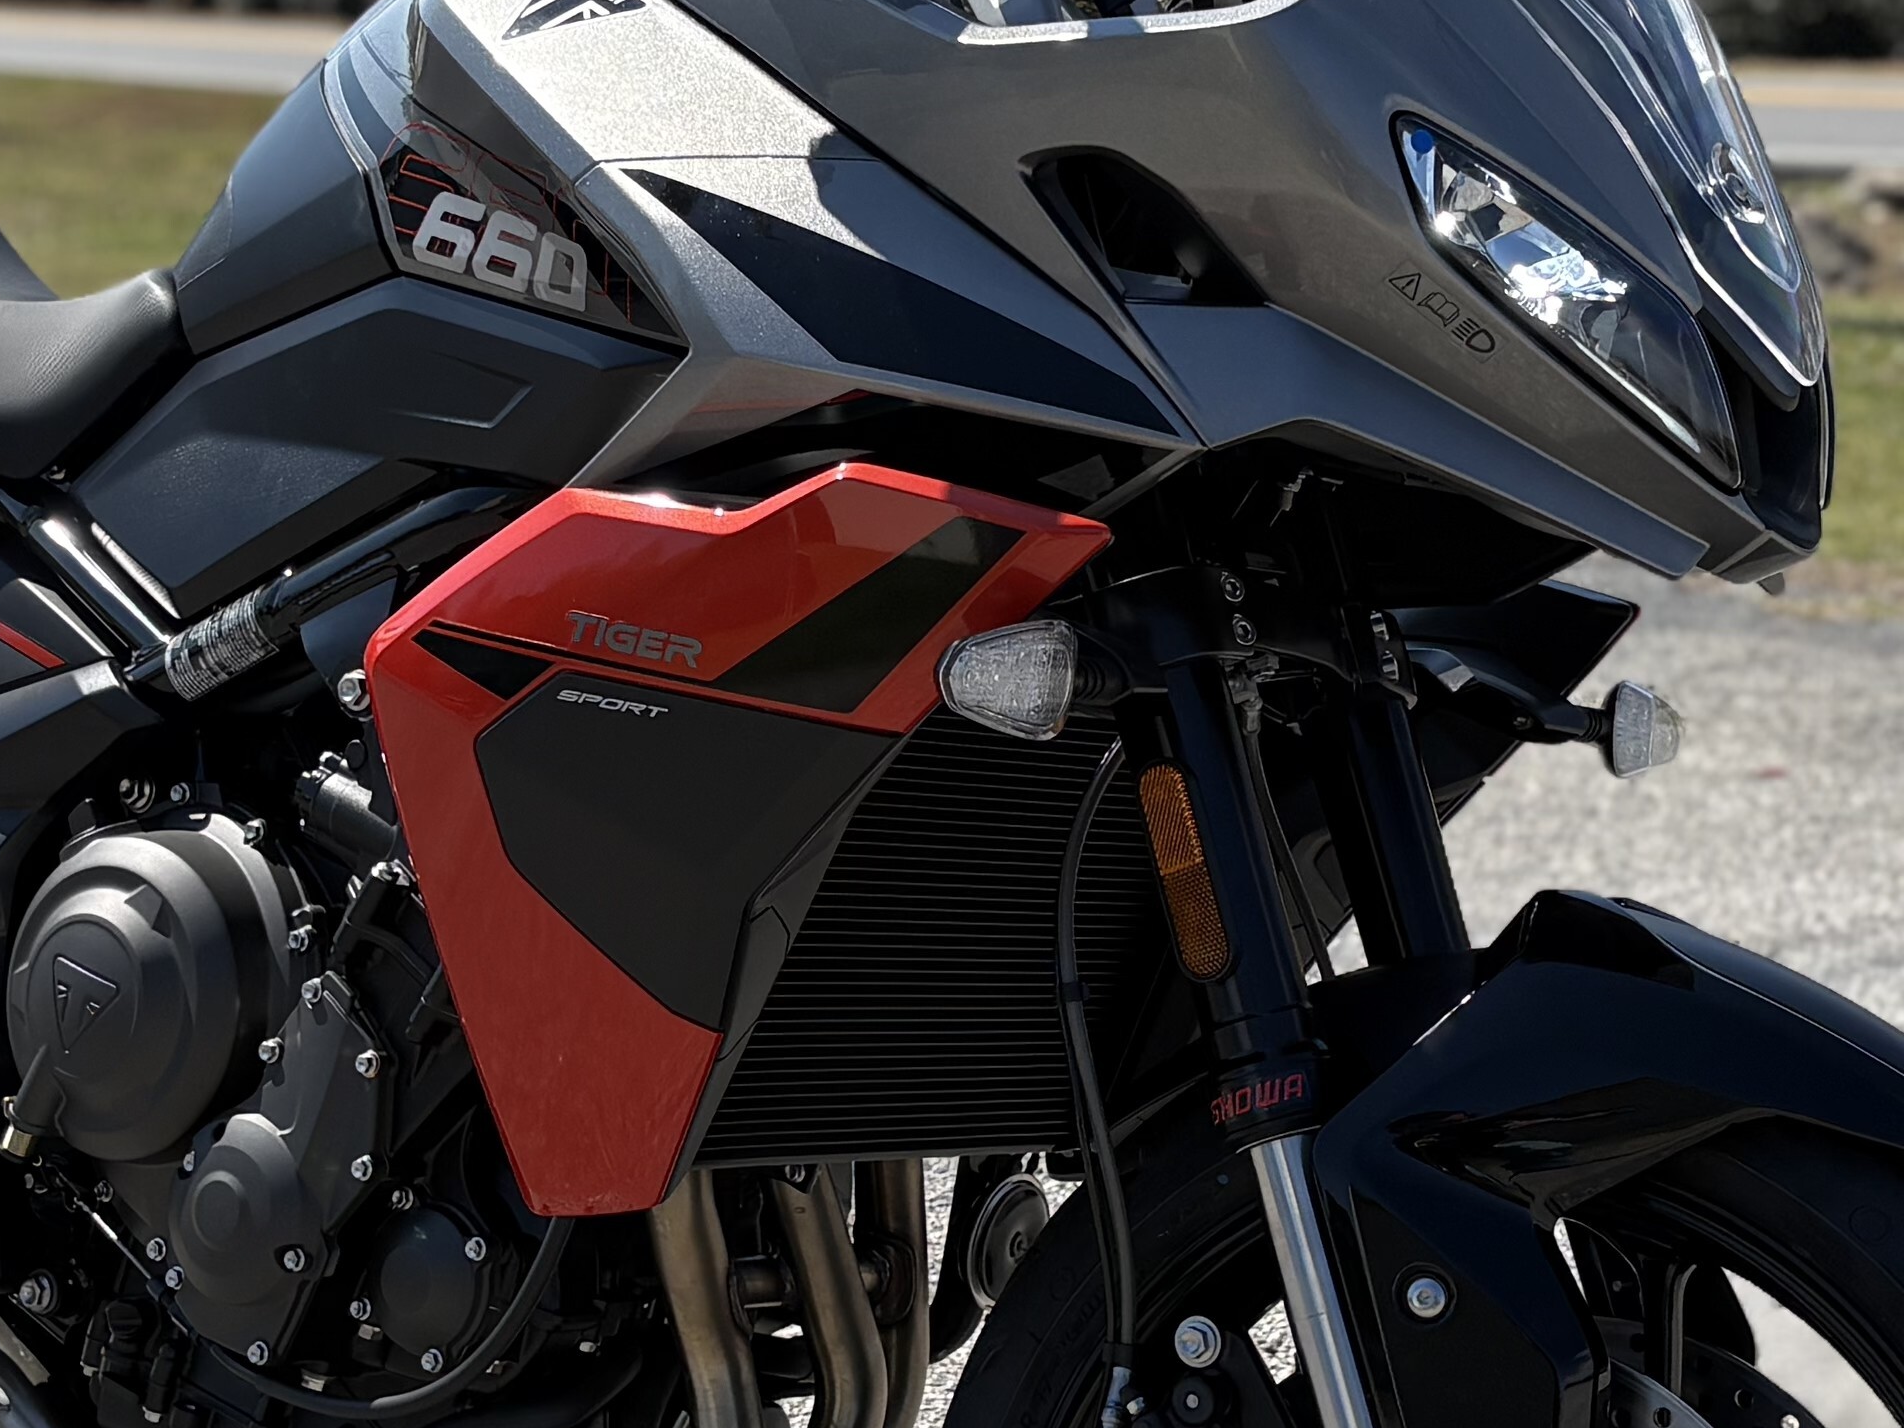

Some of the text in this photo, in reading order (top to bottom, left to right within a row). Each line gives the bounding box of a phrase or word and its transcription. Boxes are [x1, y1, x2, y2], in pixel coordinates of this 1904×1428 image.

[412, 191, 588, 312] 660
[565, 610, 703, 669] TIGER
[556, 689, 669, 718] SPORT
[1210, 1073, 1304, 1126] SHOWA
